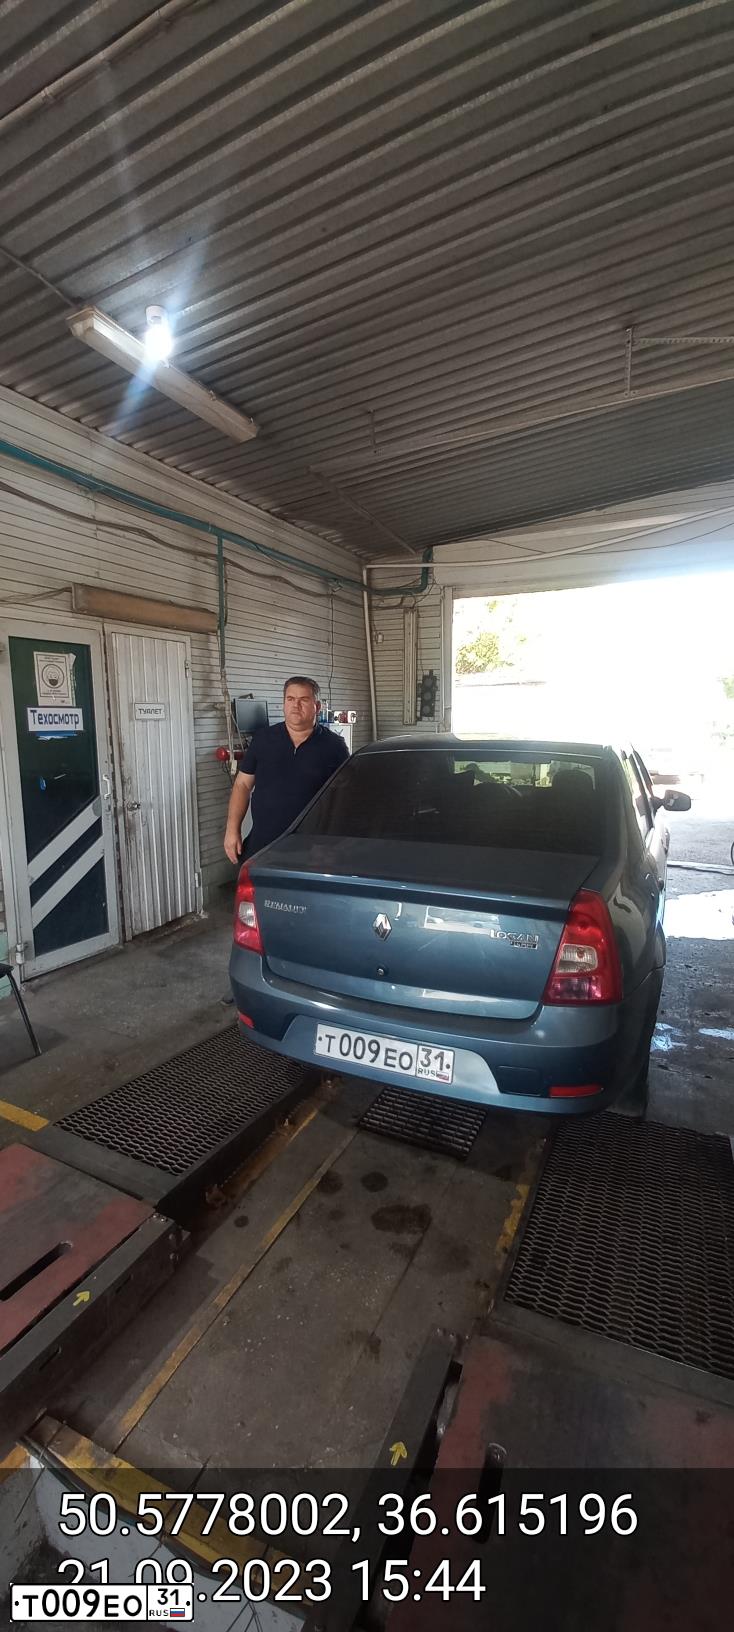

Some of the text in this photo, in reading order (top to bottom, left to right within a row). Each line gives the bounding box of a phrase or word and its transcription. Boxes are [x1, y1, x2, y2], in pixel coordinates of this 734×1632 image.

[30, 709, 80, 729] Техосмотр
[420, 1047, 445, 1071] 31
[418, 1068, 437, 1077] RUS
